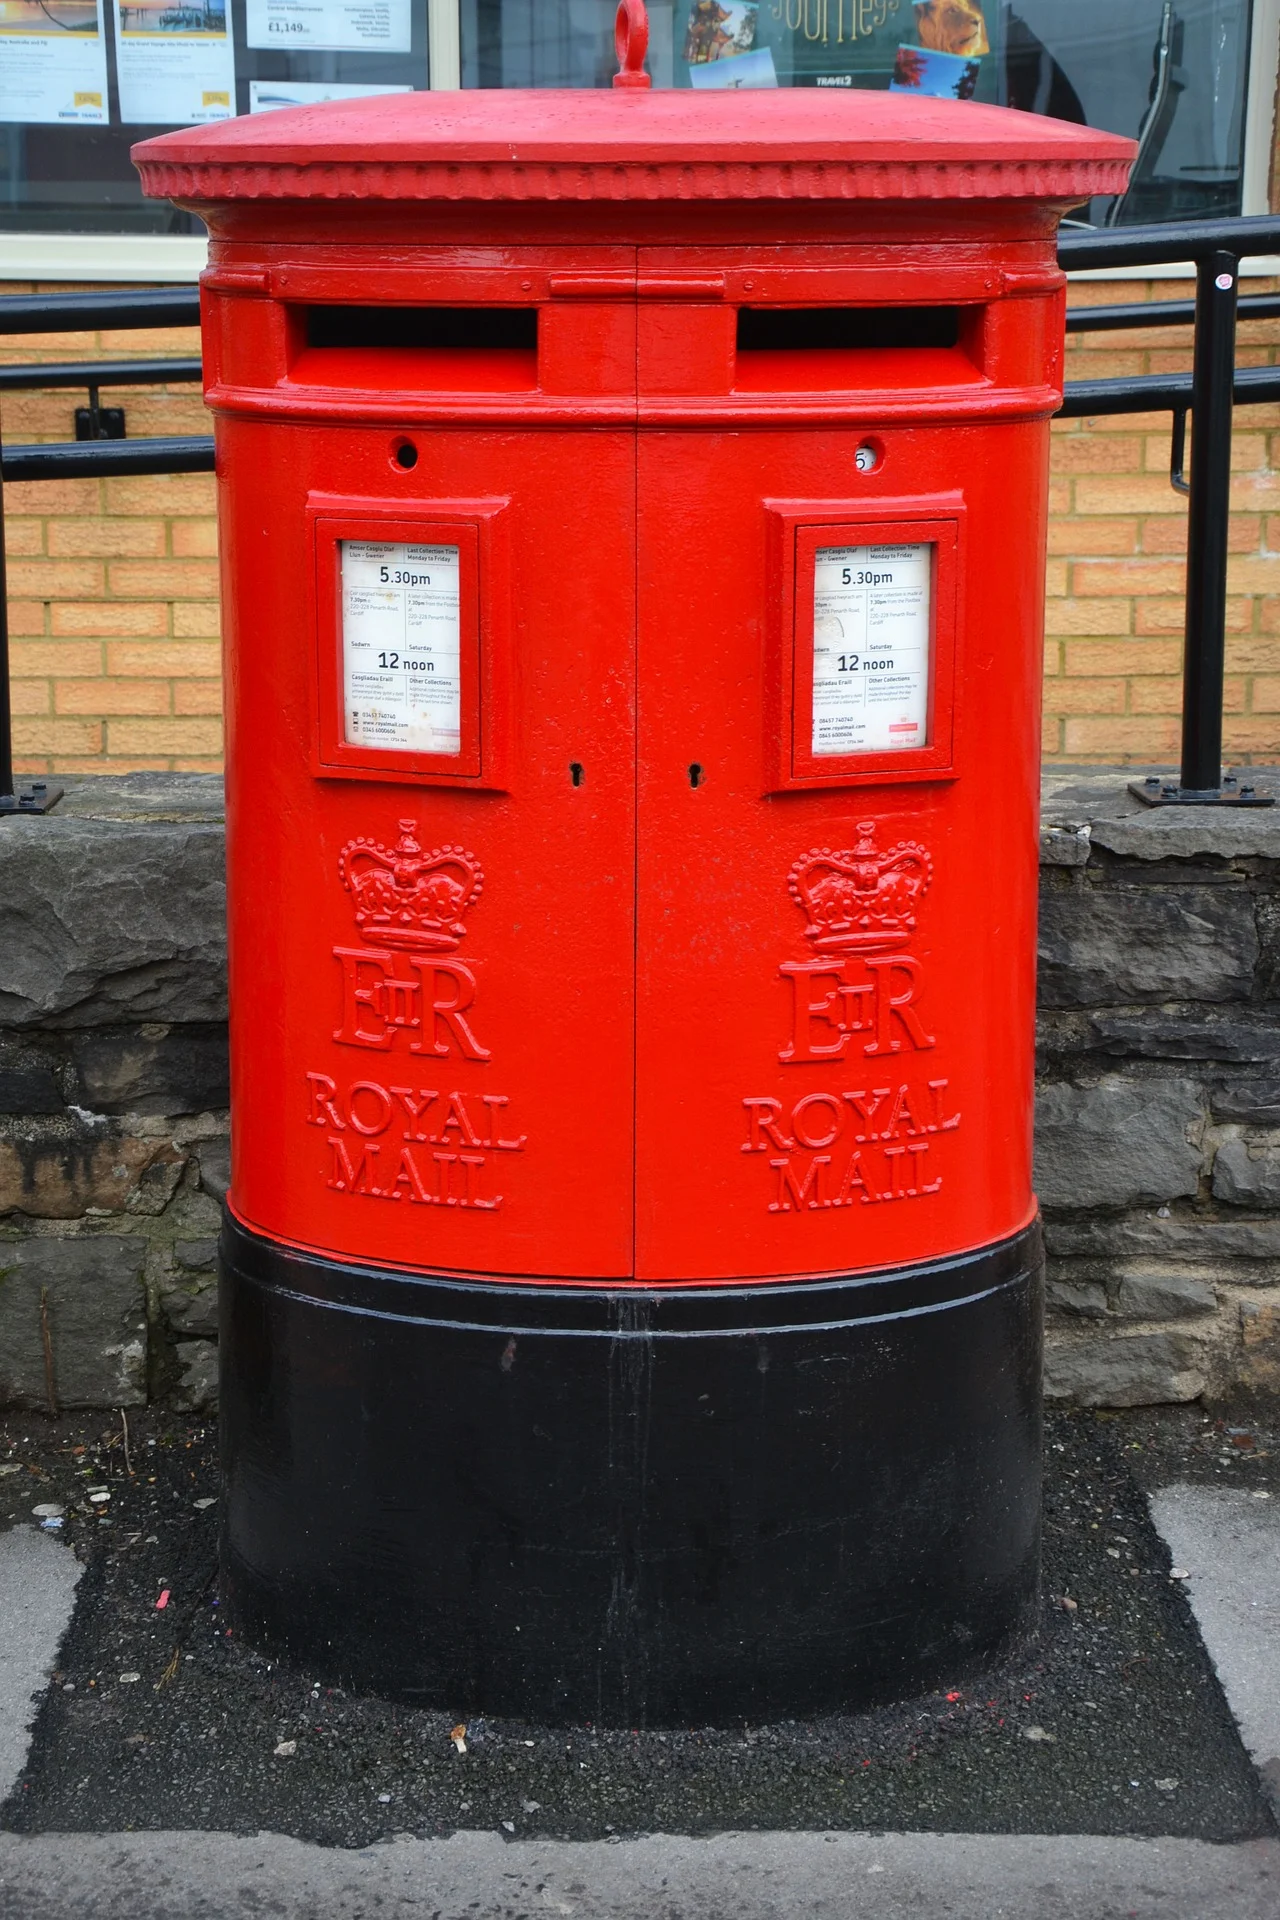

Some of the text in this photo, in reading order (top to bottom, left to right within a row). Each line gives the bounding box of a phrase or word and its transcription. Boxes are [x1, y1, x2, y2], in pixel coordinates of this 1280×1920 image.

[268, 22, 304, 34] £1,149
[856, 452, 866, 470] 5
[380, 566, 430, 586] 5.30pm
[842, 568, 893, 586] 5.30pm
[378, 652, 434, 672] 12 noon
[838, 654, 894, 672] 12 noon
[818, 724, 866, 732] www.royalmail.com
[306, 1071, 527, 1151] ROYAL
[741, 1079, 961, 1152] ROYAL
[327, 1136, 503, 1210] MAIL
[768, 1143, 943, 1212] MAIL
